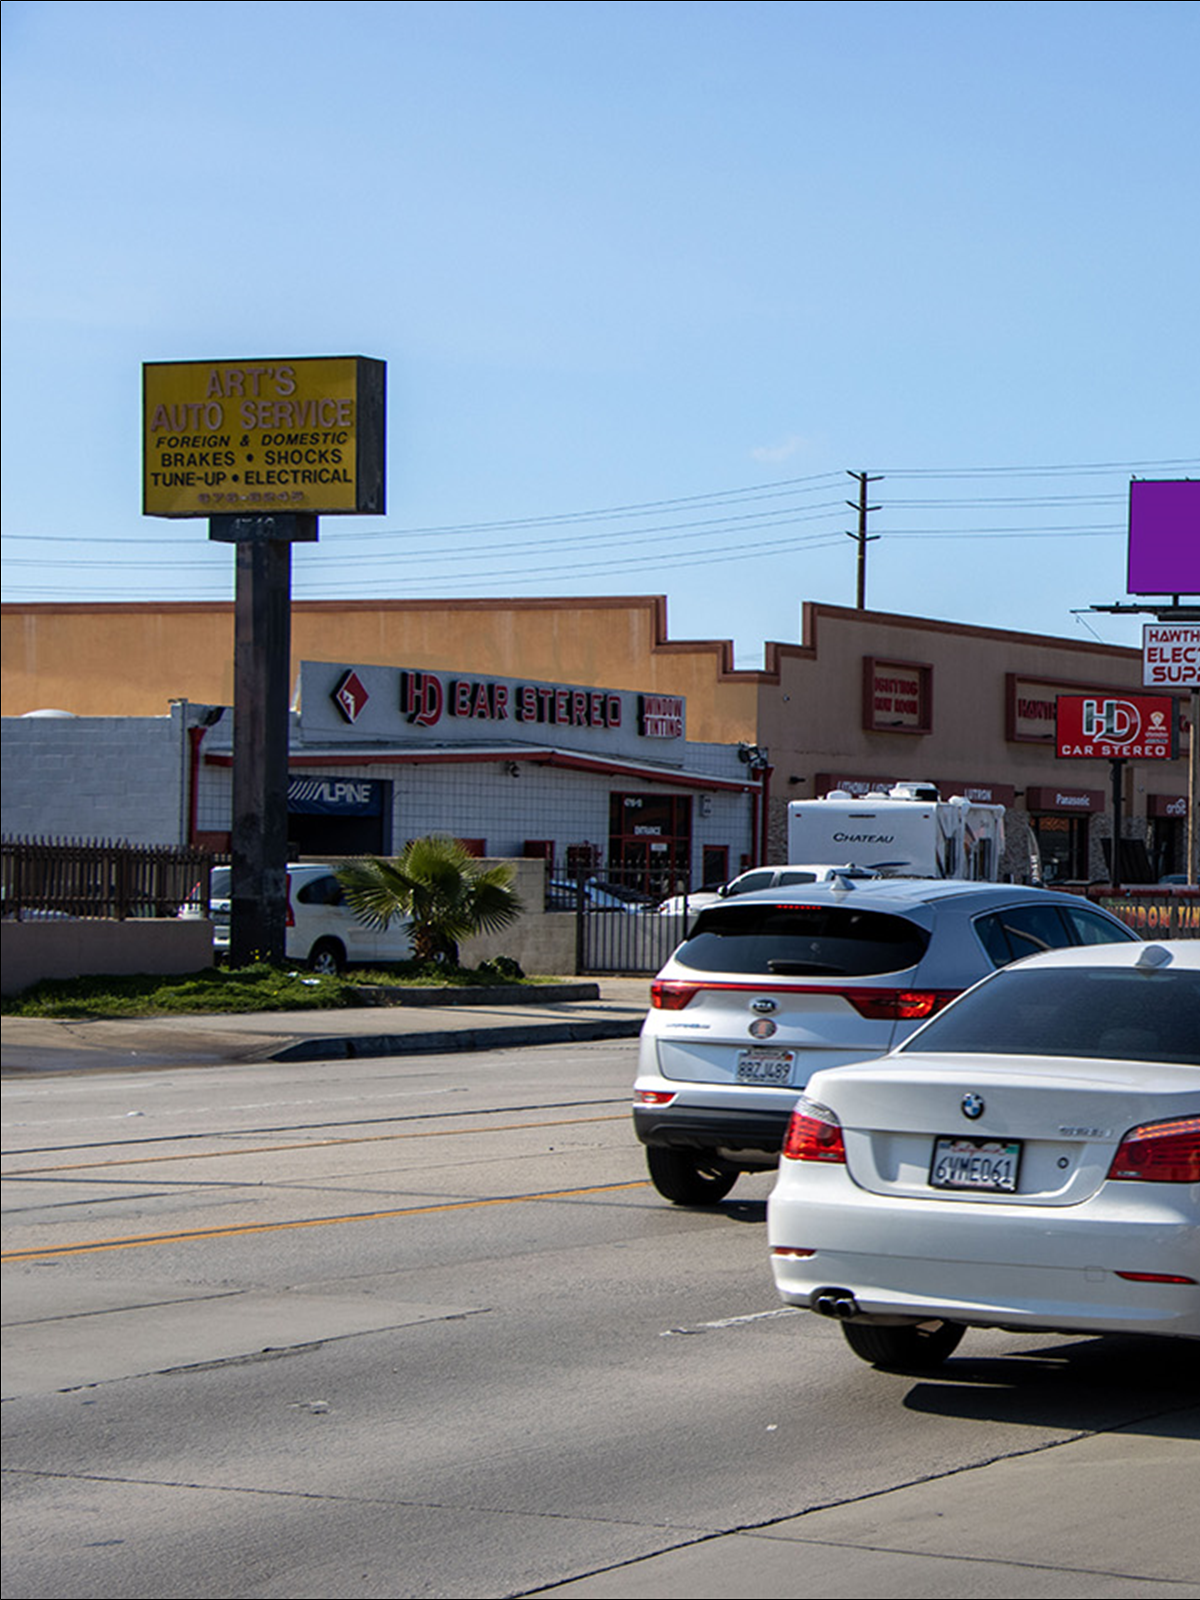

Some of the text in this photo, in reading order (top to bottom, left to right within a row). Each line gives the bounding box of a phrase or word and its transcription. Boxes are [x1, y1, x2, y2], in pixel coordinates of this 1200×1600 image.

[206, 366, 296, 399] ART'S
[151, 399, 354, 432] AUTO SERVICE
[156, 432, 348, 448] FOREIGN & DOMESTIC
[161, 449, 342, 468] BRAKES SHOCKS
[151, 469, 353, 486] TUNE-UP ELECTRICAL
[455, 681, 509, 720] CAR
[521, 686, 622, 728] STEREO
[644, 695, 683, 718] WINDOW
[644, 716, 683, 738] TINTING
[1082, 700, 1141, 746] HD
[1061, 744, 1167, 756] CAR STEREO
[313, 782, 372, 803] ALPINE
[1056, 793, 1090, 806] Panasonic
[832, 832, 895, 844] CHATEAU
